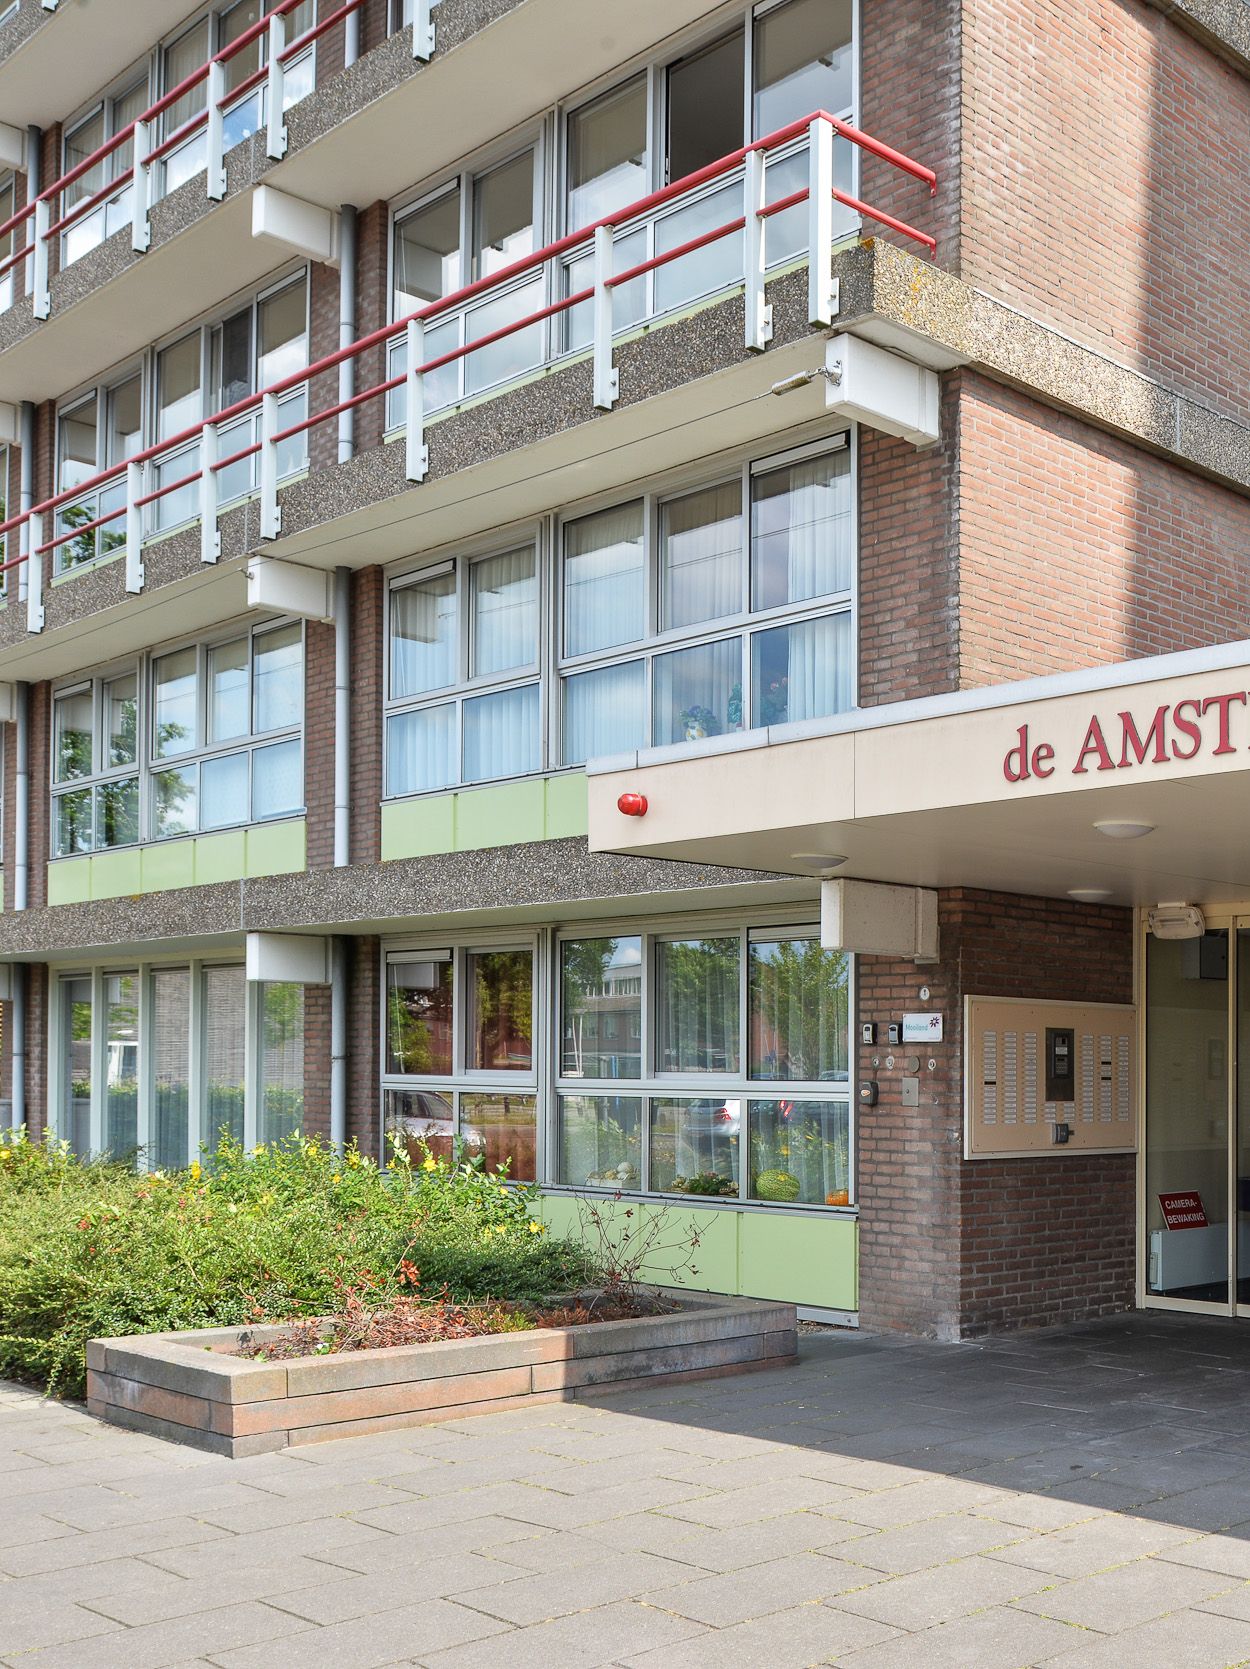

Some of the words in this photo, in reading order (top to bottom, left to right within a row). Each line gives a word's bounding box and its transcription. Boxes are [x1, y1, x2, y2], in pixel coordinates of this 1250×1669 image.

[1003, 724, 1055, 782] de
[1165, 1199, 1198, 1210] CAMERA-
[1167, 1212, 1205, 1224] BEWAKING
